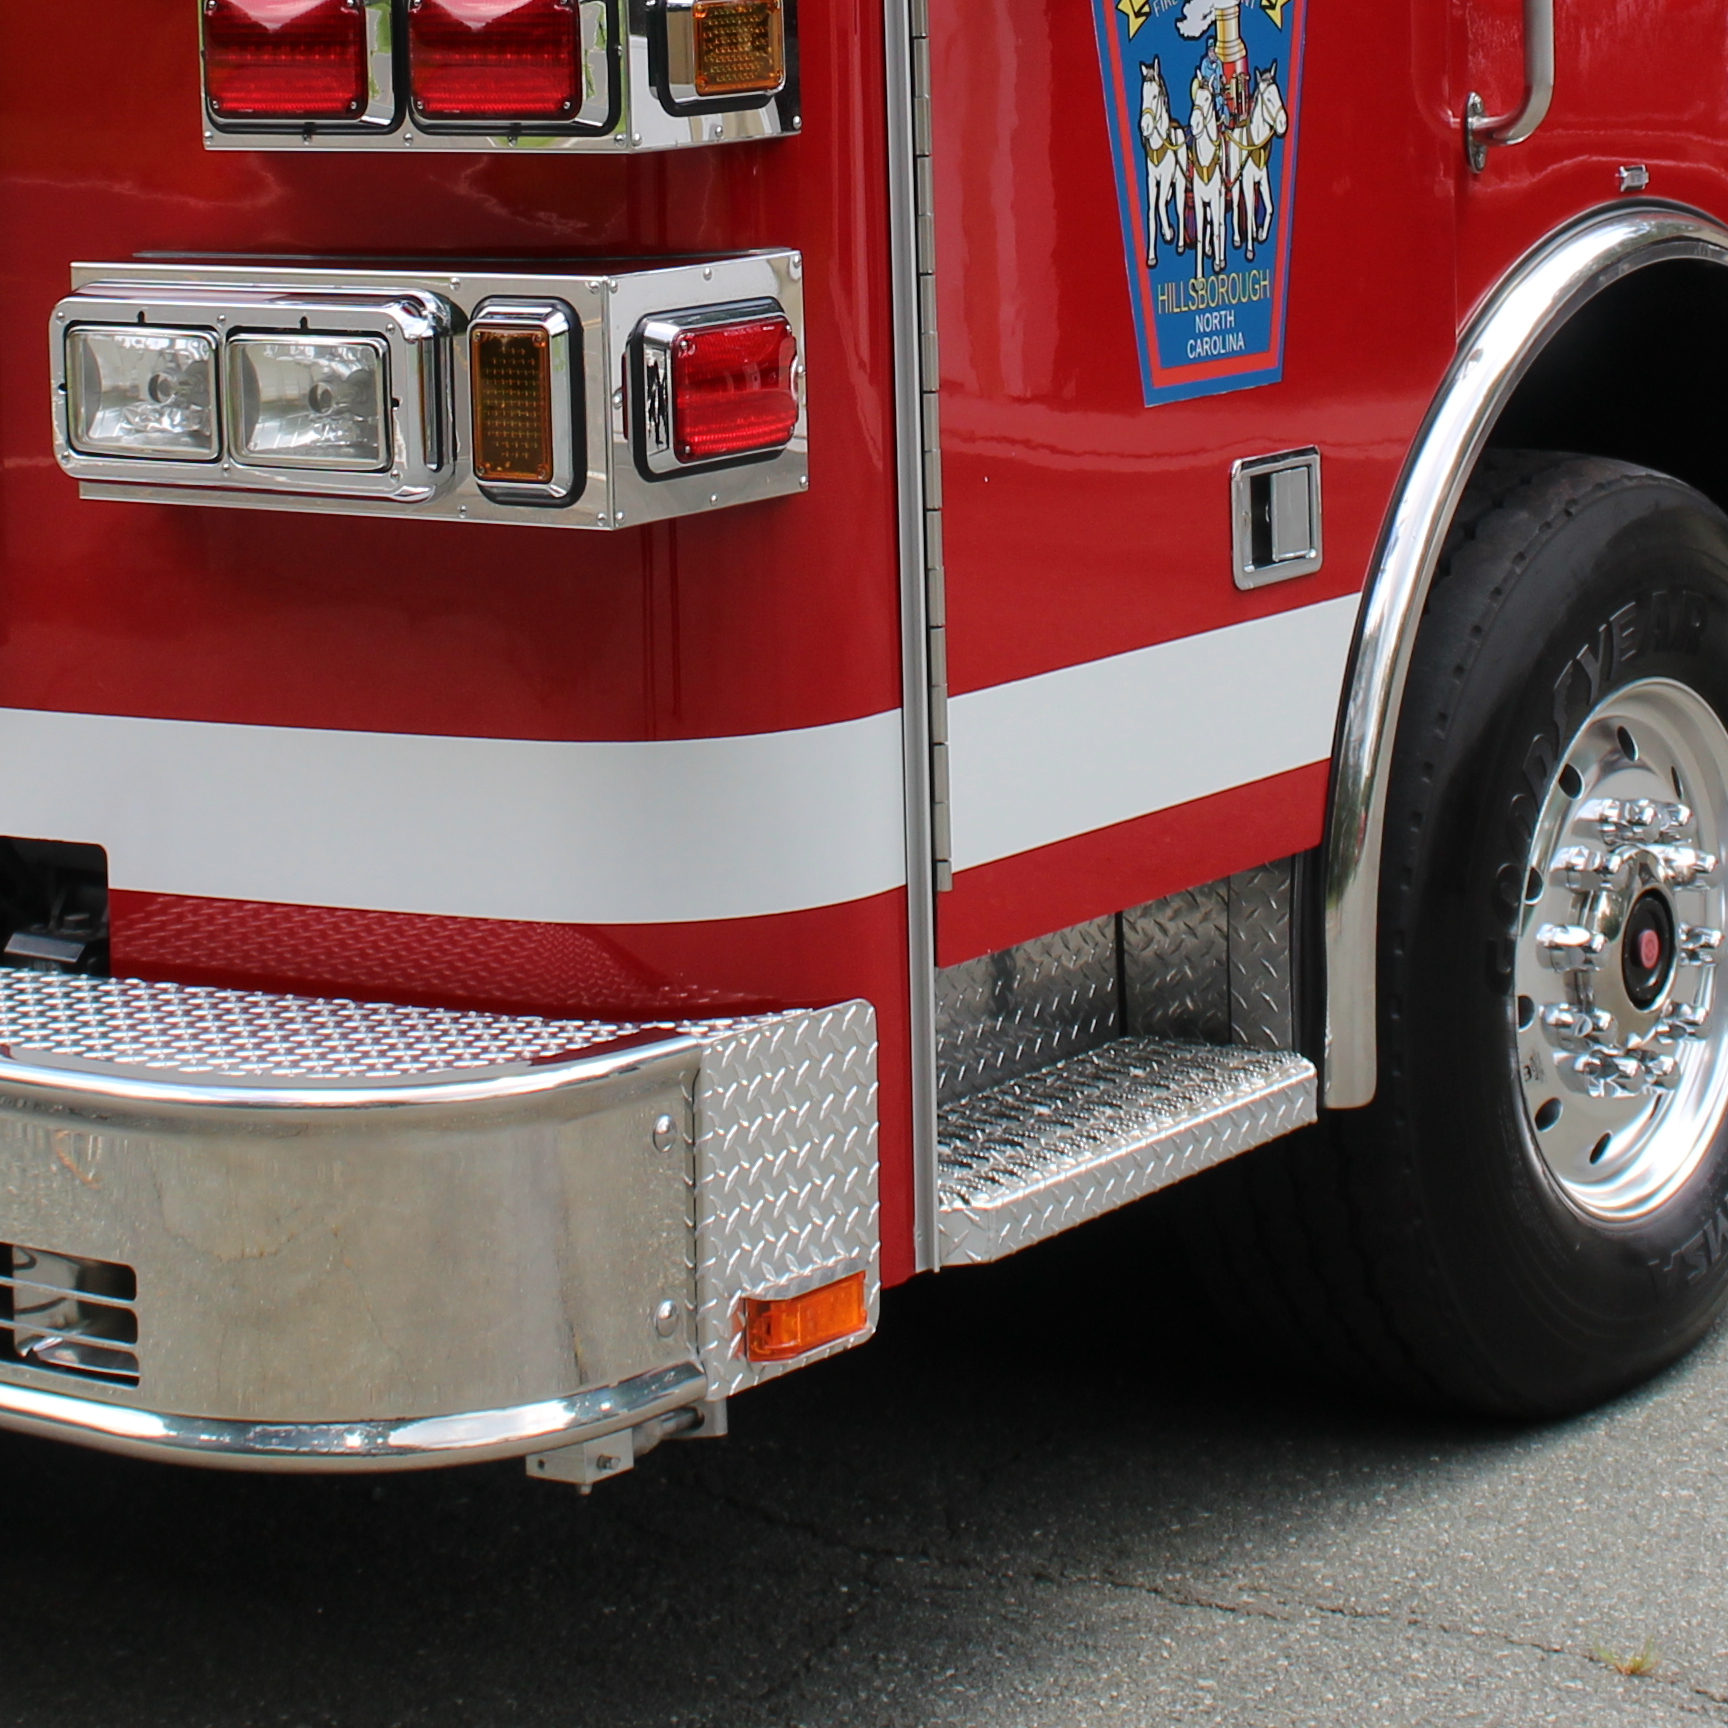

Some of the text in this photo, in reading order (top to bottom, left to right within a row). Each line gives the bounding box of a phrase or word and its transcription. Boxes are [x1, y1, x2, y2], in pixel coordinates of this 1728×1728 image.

[1158, 268, 1270, 314] HILLSBOROUGH
[1195, 309, 1235, 333] NORTH
[1187, 331, 1245, 359] CAROLINA
